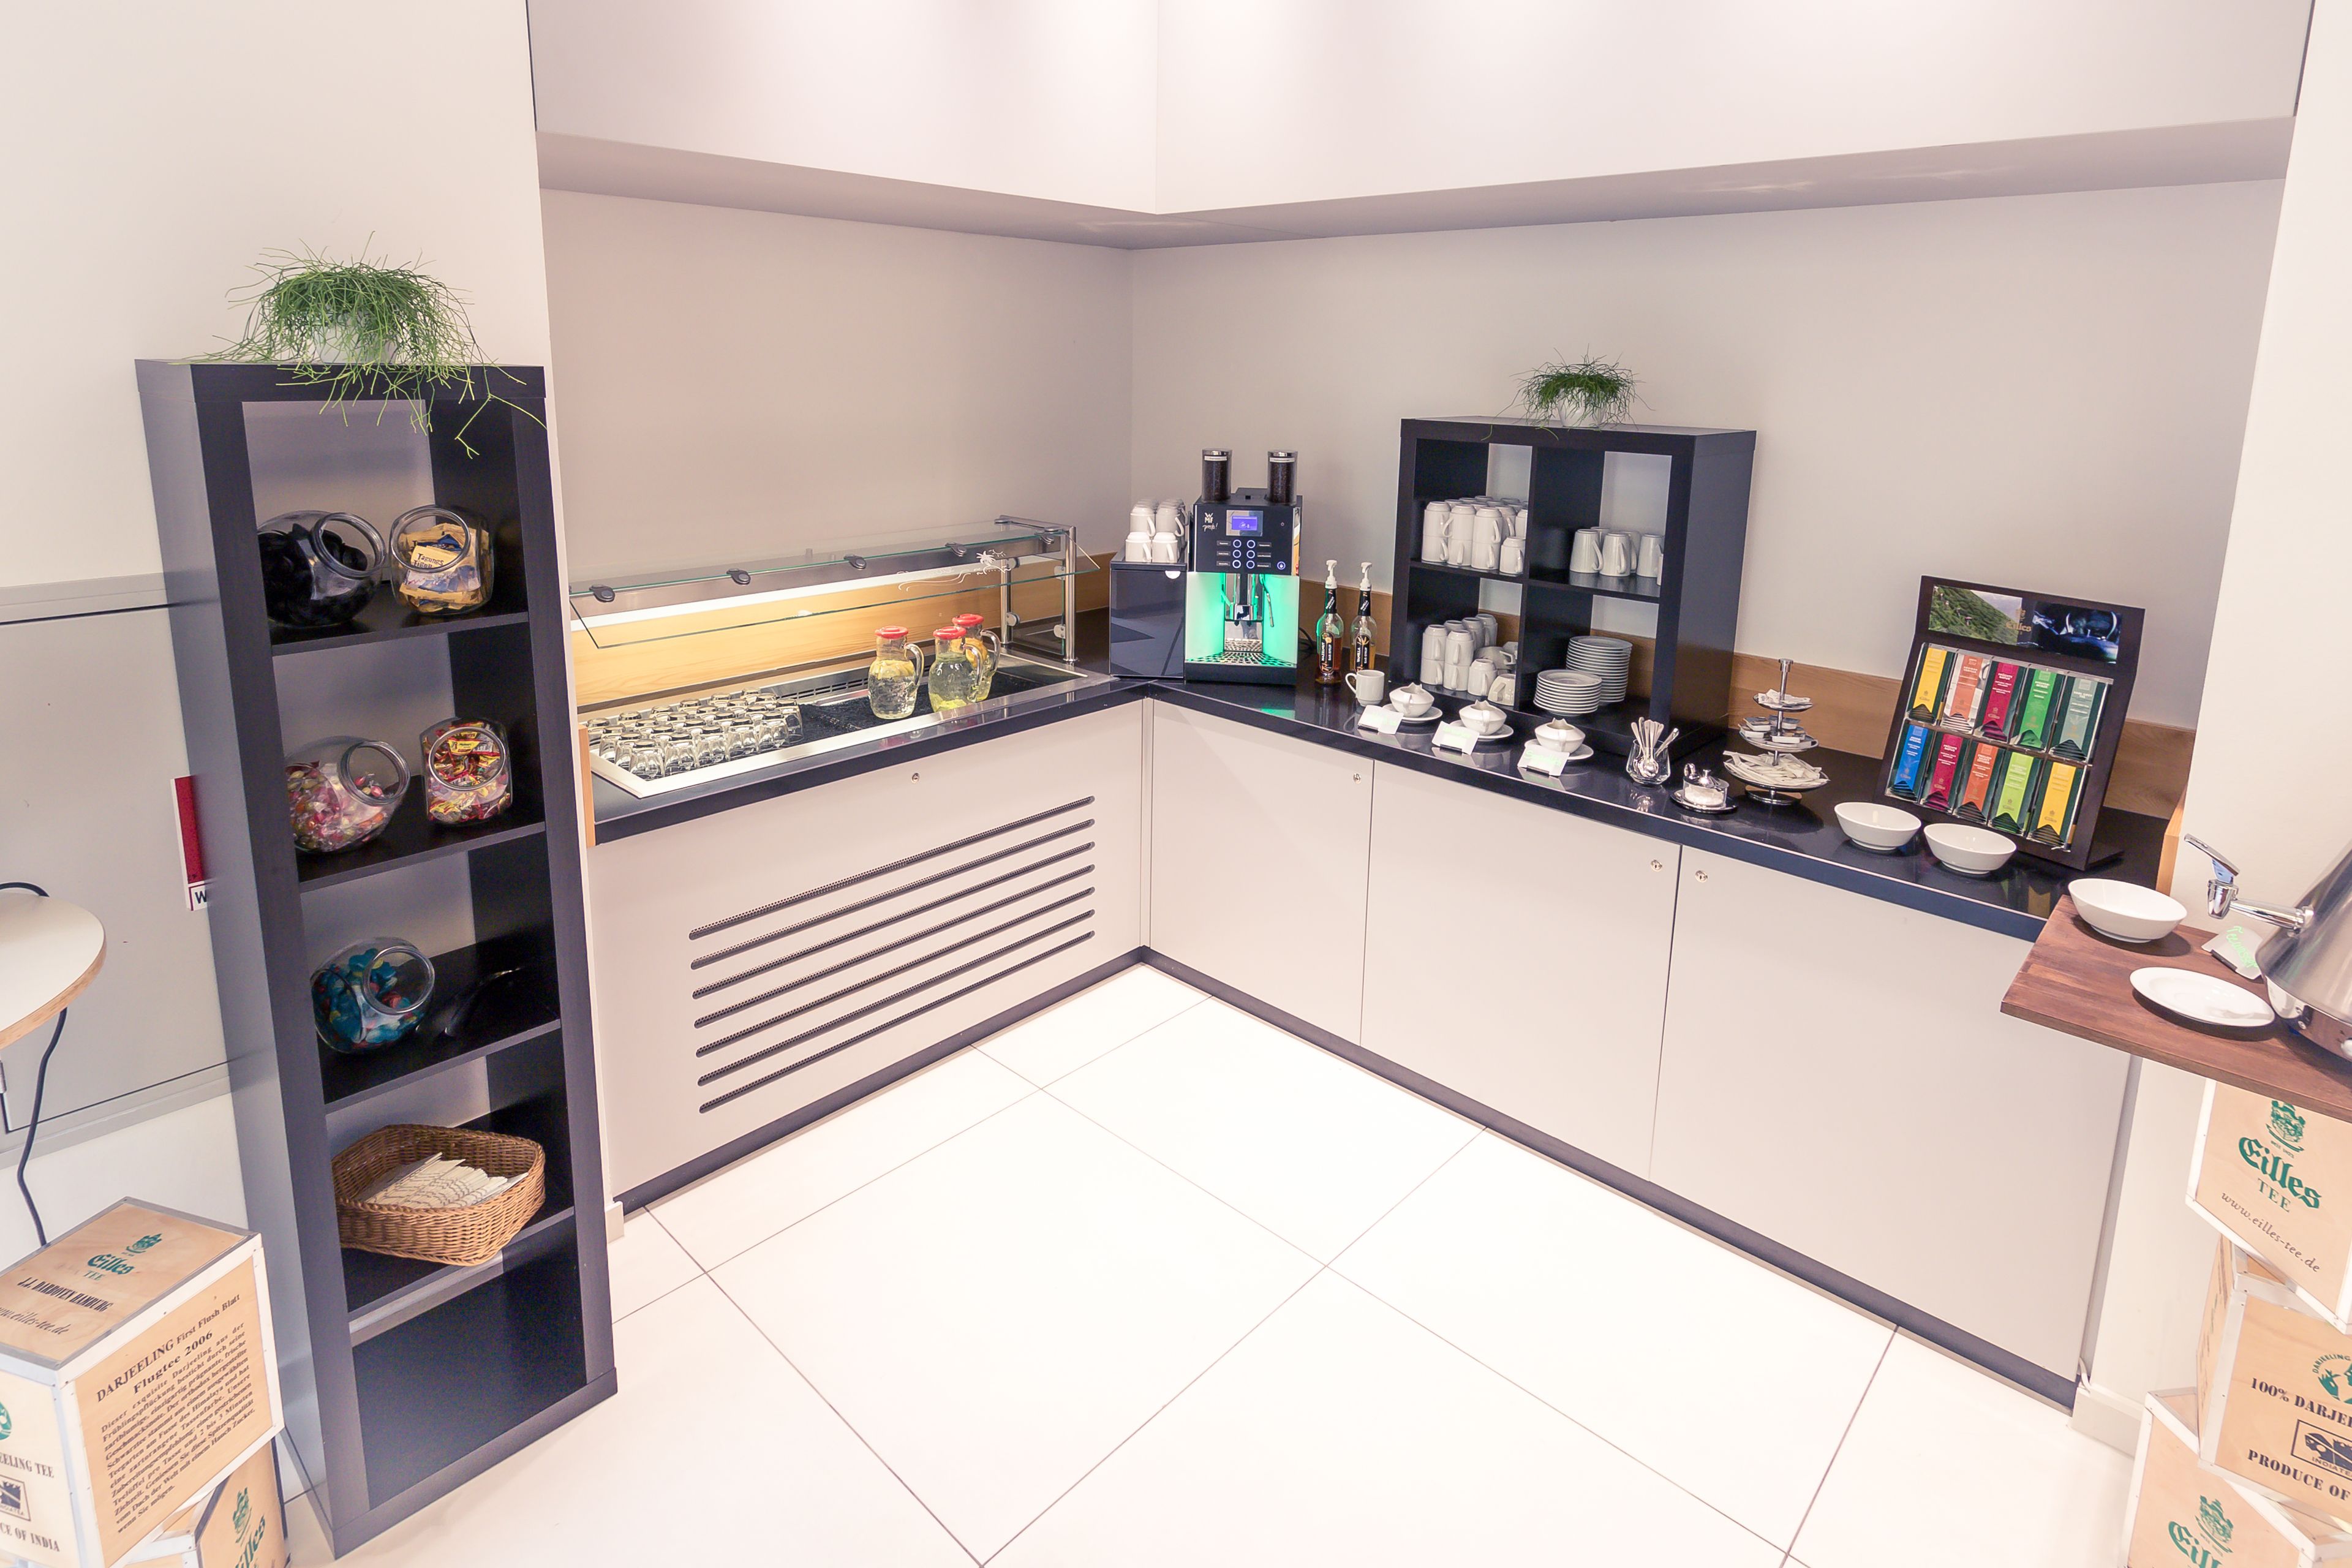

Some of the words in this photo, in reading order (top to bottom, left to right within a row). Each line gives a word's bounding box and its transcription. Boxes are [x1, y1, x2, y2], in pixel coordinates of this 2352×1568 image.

[2238, 1136, 2322, 1209] Eilles
[2257, 1177, 2291, 1213] TEE
[2221, 1191, 2321, 1273] www.eilles-tee.de
[83, 1269, 106, 1281] TEE
[88, 1254, 135, 1275] Eilles
[69, 1293, 114, 1312] HAMBURG
[97, 1339, 173, 1401] DARJEELING
[176, 1326, 195, 1344] First
[198, 1310, 219, 1328] Flush
[222, 1294, 239, 1311] Blatt
[101, 1410, 127, 1433] Dieser
[132, 1380, 167, 1409] exquisite
[172, 1347, 211, 1378] Darjeeling
[216, 1335, 227, 1346] aus
[232, 1322, 244, 1333] der
[134, 1355, 180, 1393] Flugtee
[184, 1330, 212, 1356] 2006
[151, 1385, 186, 1414] einzigartig
[225, 1340, 246, 1358] frische
[2312, 1353, 2351, 1374] DARJEELING
[103, 1384, 175, 1441] Frühlingspflückung
[177, 1361, 204, 1384] besticht
[206, 1345, 226, 1362] durch
[228, 1332, 244, 1346] seine
[167, 1400, 179, 1412] Der
[181, 1376, 209, 1401] orthodox
[211, 1349, 246, 1378] hergestellte
[196, 1413, 213, 1428] einen
[214, 1382, 251, 1415] gestrichenen
[2250, 1377, 2290, 1403] 100%
[108, 1449, 143, 1478] Teegarten
[146, 1438, 156, 1449] am
[159, 1422, 177, 1439] Fusse
[179, 1411, 190, 1422] des
[192, 1385, 223, 1412] Himalaya
[225, 1373, 237, 1386] und
[239, 1365, 249, 1376] hat
[110, 1474, 125, 1488] eine
[129, 1431, 177, 1472] zartorangene
[227, 1374, 249, 1393] Unsere
[145, 1461, 178, 1489] Geniessen
[179, 1451, 189, 1462] Sie
[190, 1438, 206, 1452] diese
[208, 1399, 253, 1438] Spitzenqualität
[148, 1414, 172, 1437] stammt
[174, 1406, 185, 1417] aus
[186, 1390, 205, 1406] einem
[34, 1462, 55, 1478] TEE
[113, 1477, 144, 1506] Teelöffel
[148, 1466, 160, 1479] pro
[162, 1448, 181, 1464] Tasse
[184, 1434, 197, 1448] und
[206, 1420, 216, 1430] bis
[225, 1391, 252, 1414] Minuten
[116, 1510, 130, 1523] vom
[132, 1494, 149, 1511] Dach
[151, 1483, 162, 1495] der
[163, 1469, 178, 1483] Welt
[179, 1460, 190, 1471] mit
[191, 1444, 210, 1461] einem
[211, 1427, 231, 1445] Hauch
[2247, 1449, 2324, 1490] PRODUCE
[2329, 1485, 2351, 1502] OF
[15, 1527, 26, 1541] OF
[30, 1532, 60, 1552] INDIA
[118, 1516, 136, 1532] wenn
[138, 1506, 148, 1517] Sie
